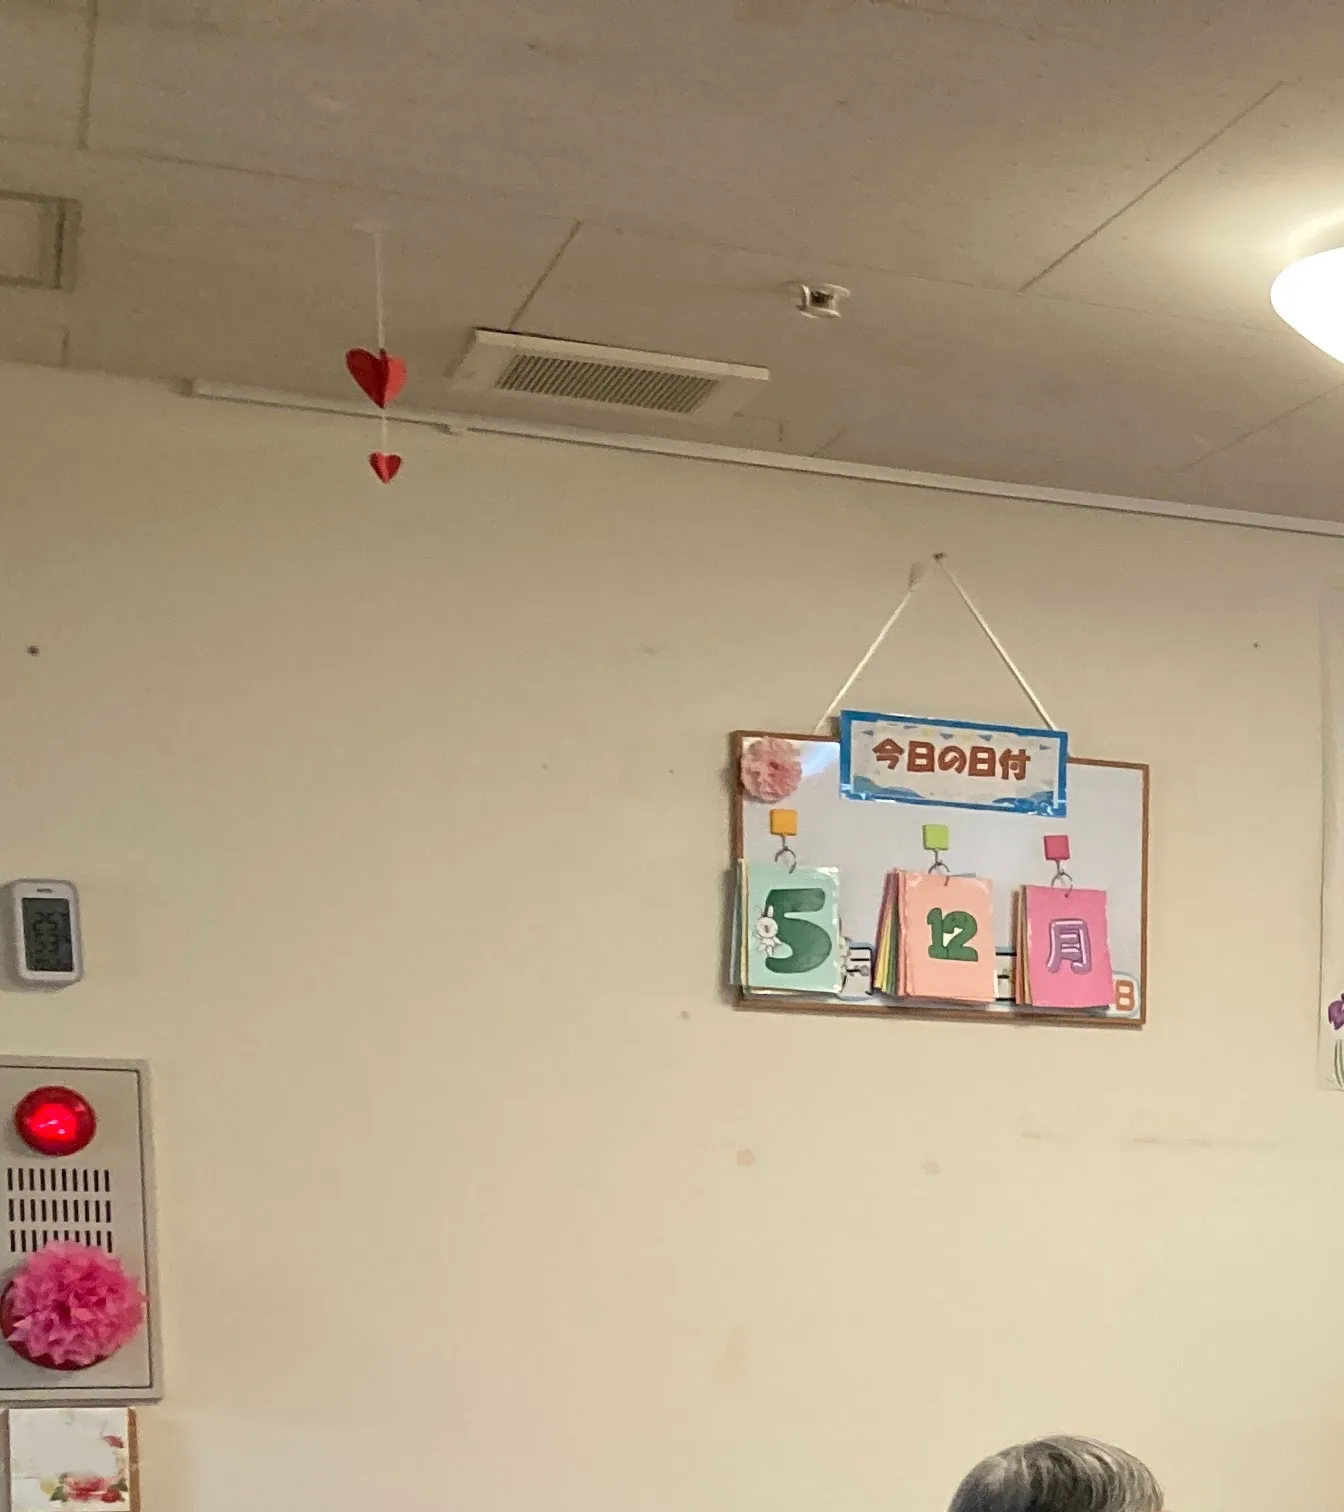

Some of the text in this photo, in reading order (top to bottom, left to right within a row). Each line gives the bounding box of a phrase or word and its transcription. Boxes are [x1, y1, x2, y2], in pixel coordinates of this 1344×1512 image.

[872, 738, 1031, 781] 今日の日付
[765, 888, 832, 973] 5
[927, 907, 978, 961] 12
[1047, 918, 1092, 974] 月
